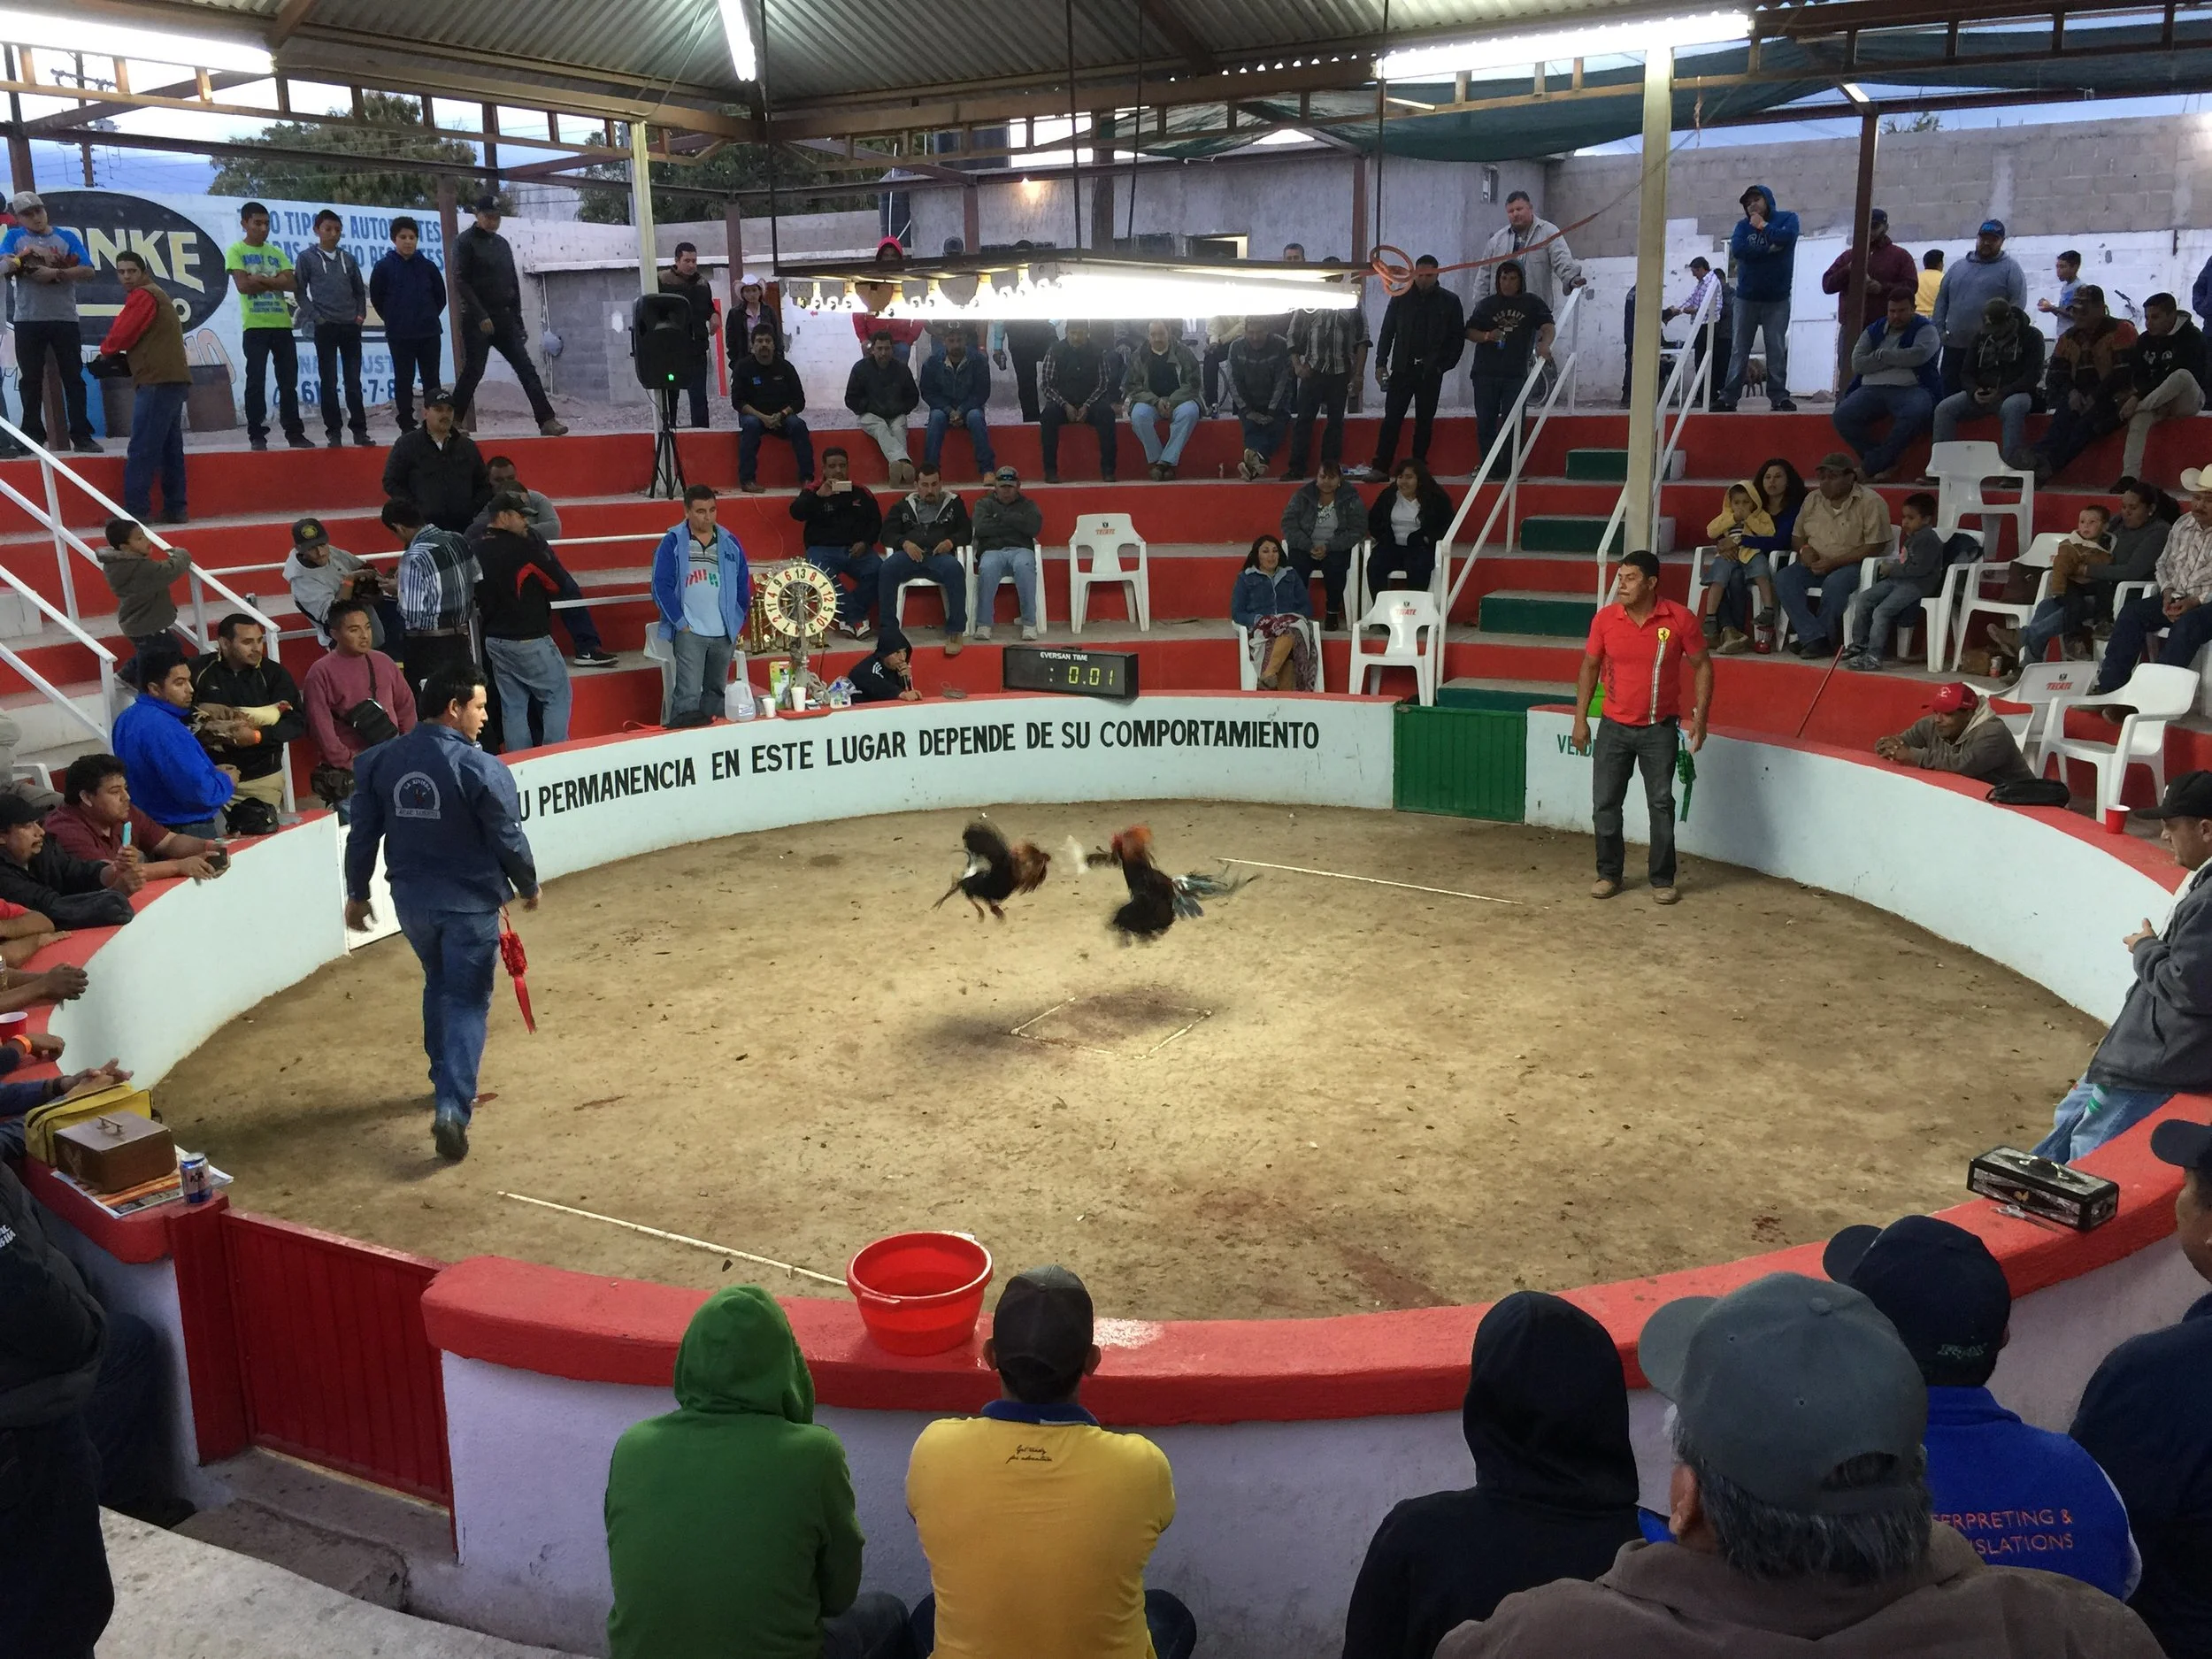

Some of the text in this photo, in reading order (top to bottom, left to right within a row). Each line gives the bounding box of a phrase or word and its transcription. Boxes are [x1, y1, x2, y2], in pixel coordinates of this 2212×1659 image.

[350, 215, 442, 242] AUTOTES
[53, 226, 204, 294] NKE
[784, 571, 792, 581] 6
[795, 569, 806, 579] 13
[810, 572, 817, 581] 8
[773, 579, 782, 588] 9
[823, 591, 834, 603] 12
[766, 603, 777, 612] 11
[816, 615, 828, 627] 10
[782, 623, 790, 633] 7
[809, 623, 816, 633] 3
[1040, 651, 1071, 660] EVERSAN
[517, 719, 1319, 822] U PERMANENCIA EN ESTE LUGAR DEPENDE DE SU COMPORTAMIENTO
[2062, 1509, 2072, 1525] &
[1970, 1532, 2073, 1555] SLATIONS
